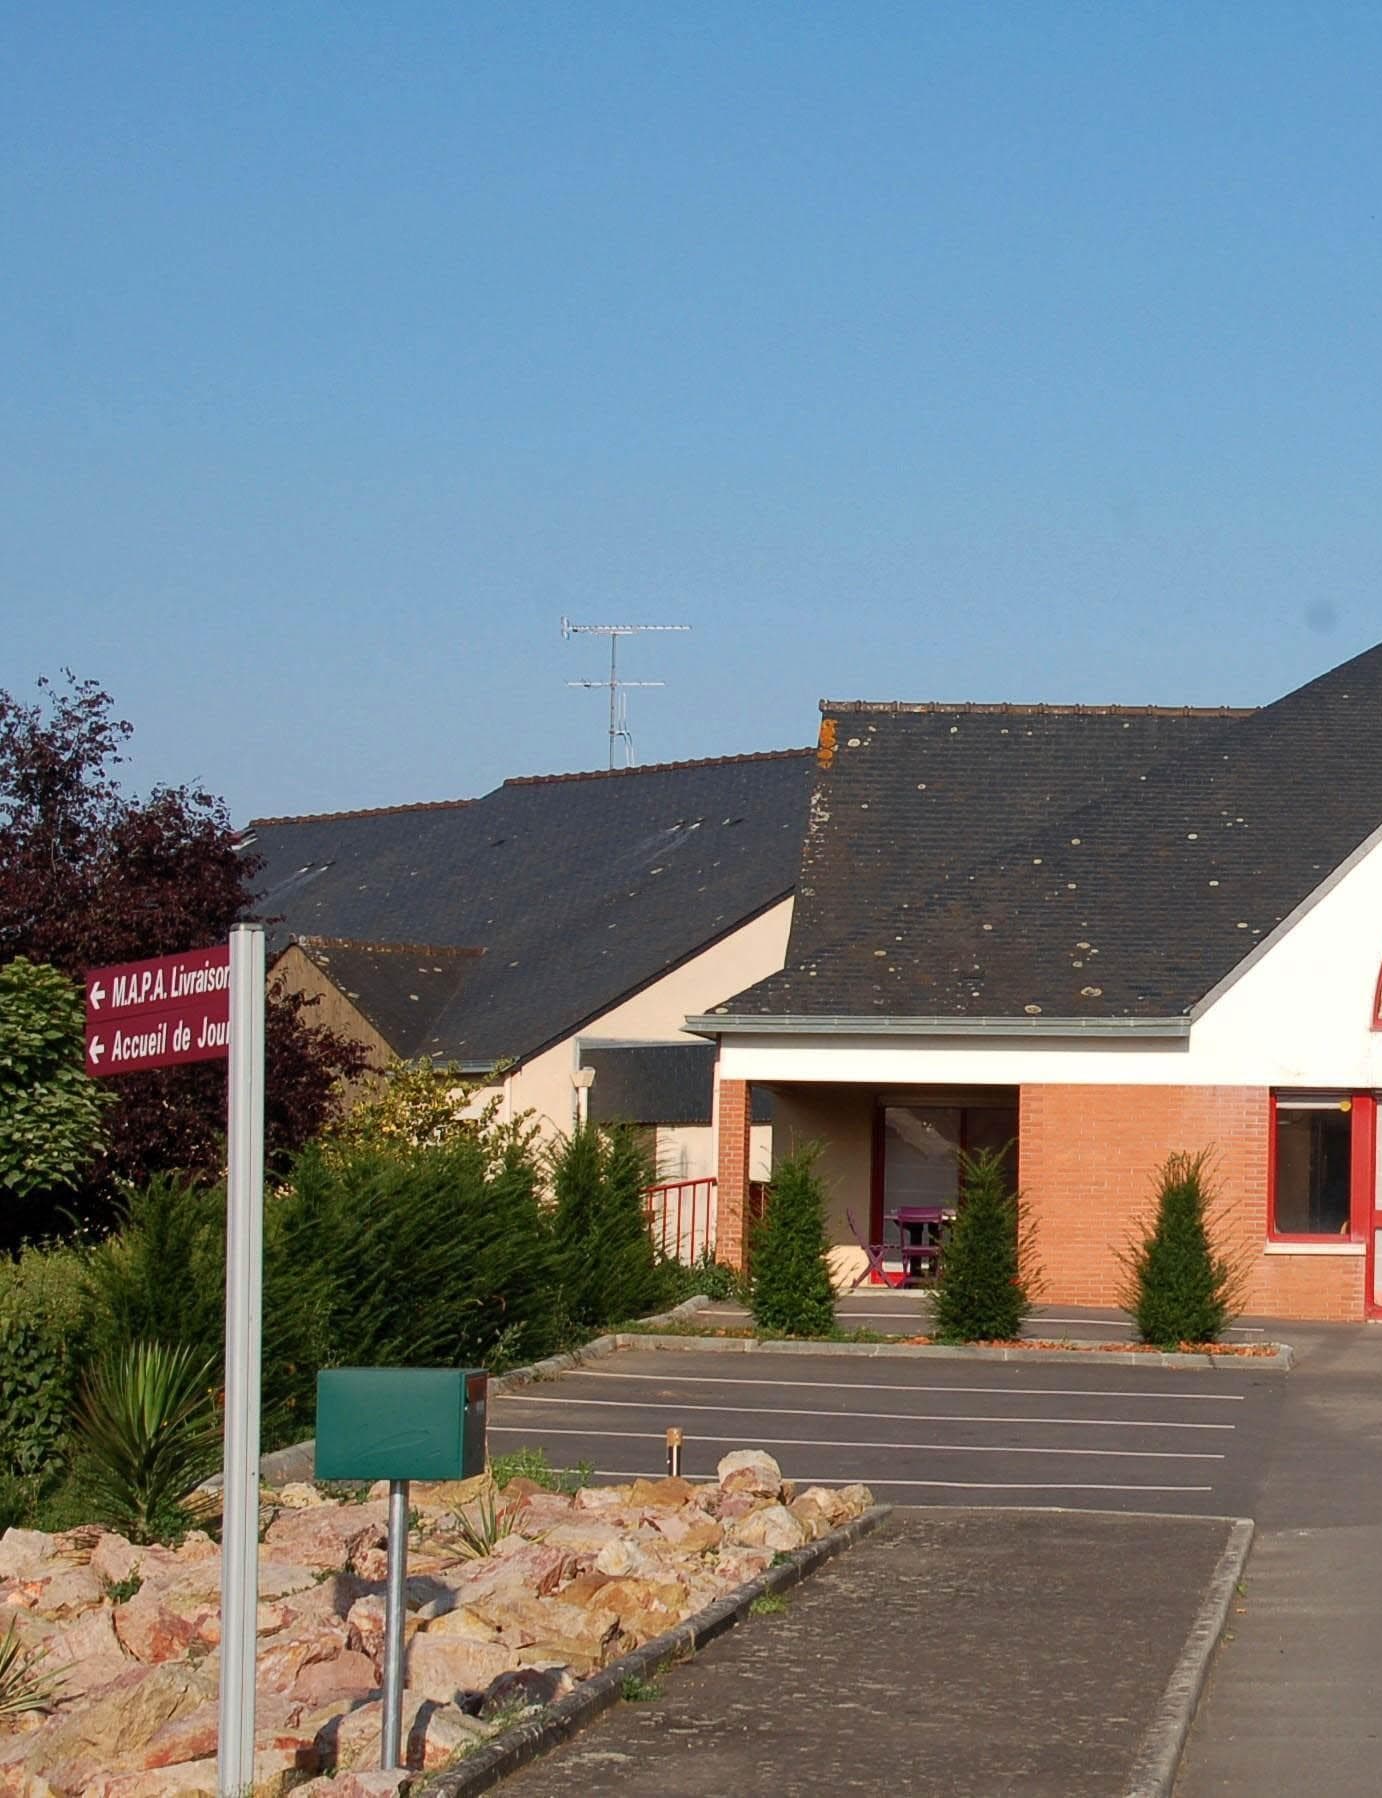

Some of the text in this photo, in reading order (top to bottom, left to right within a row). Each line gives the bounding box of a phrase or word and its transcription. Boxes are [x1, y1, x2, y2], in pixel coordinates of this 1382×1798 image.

[111, 968, 168, 1008] M.A.P.A.
[111, 1022, 168, 1062] Accueil
[173, 1019, 191, 1052] de
